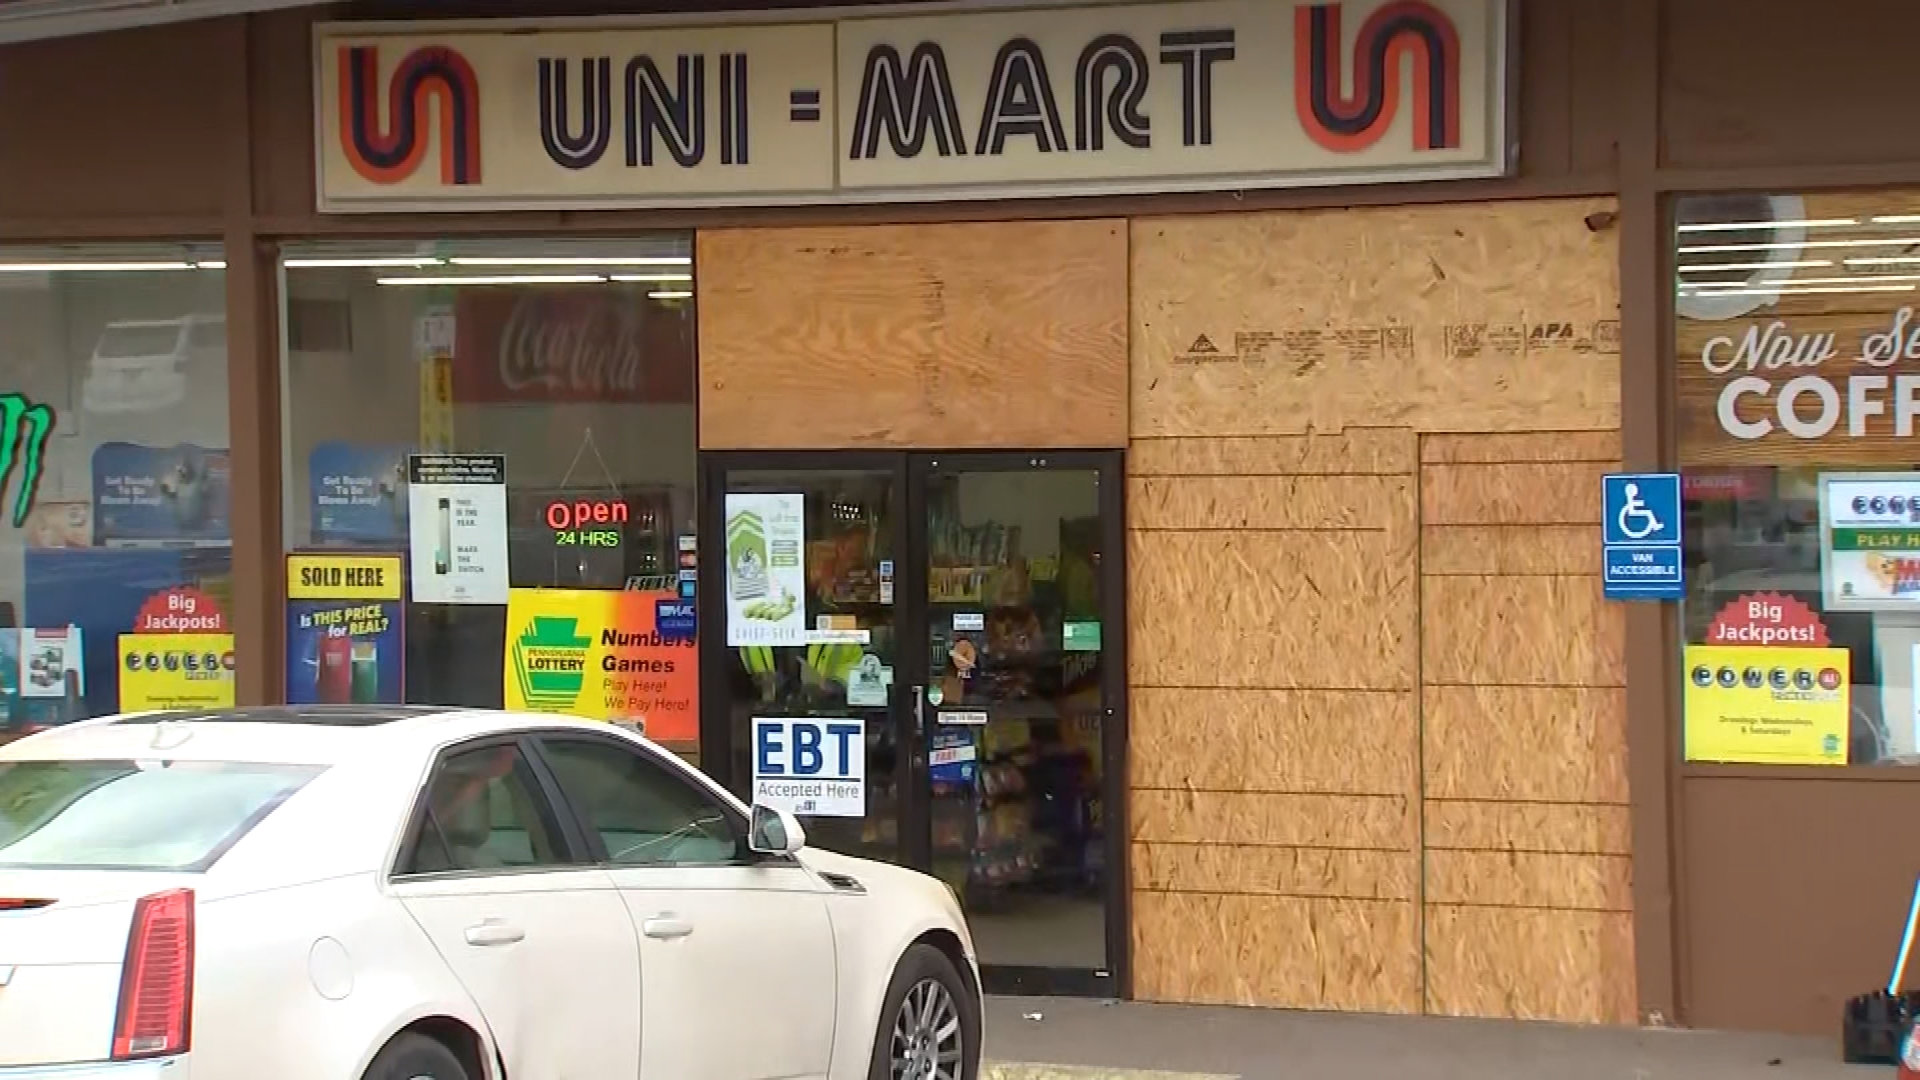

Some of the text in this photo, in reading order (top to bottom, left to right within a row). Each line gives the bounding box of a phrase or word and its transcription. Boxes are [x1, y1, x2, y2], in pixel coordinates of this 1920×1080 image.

[537, 52, 749, 170] UNI
[849, 29, 1236, 159] MART
[1529, 323, 1573, 339] APA
[1702, 321, 1838, 374] Now
[547, 500, 628, 530] Open
[556, 531, 619, 547] 24 HRS
[1856, 533, 1902, 547] PLAY
[1631, 553, 1654, 563] VAN
[301, 567, 384, 587] SOLD HERE
[1610, 565, 1676, 576] ACCESSIBLE
[168, 594, 196, 613] Big
[1748, 602, 1783, 623] Big
[144, 613, 220, 632] Jackpots!
[312, 609, 343, 627] THIS
[344, 603, 382, 622] PRICE
[328, 617, 389, 638] for REAL?
[1716, 625, 1816, 645] Jackpots!
[601, 629, 697, 649] Numbers
[528, 658, 585, 671] LOTTERY
[602, 654, 675, 673] Games
[603, 677, 668, 693] Play Here!
[1691, 664, 1816, 690] POWER
[604, 696, 690, 713] We Pay Here!
[757, 723, 862, 776] EBT
[758, 782, 860, 799] Accepted Here
